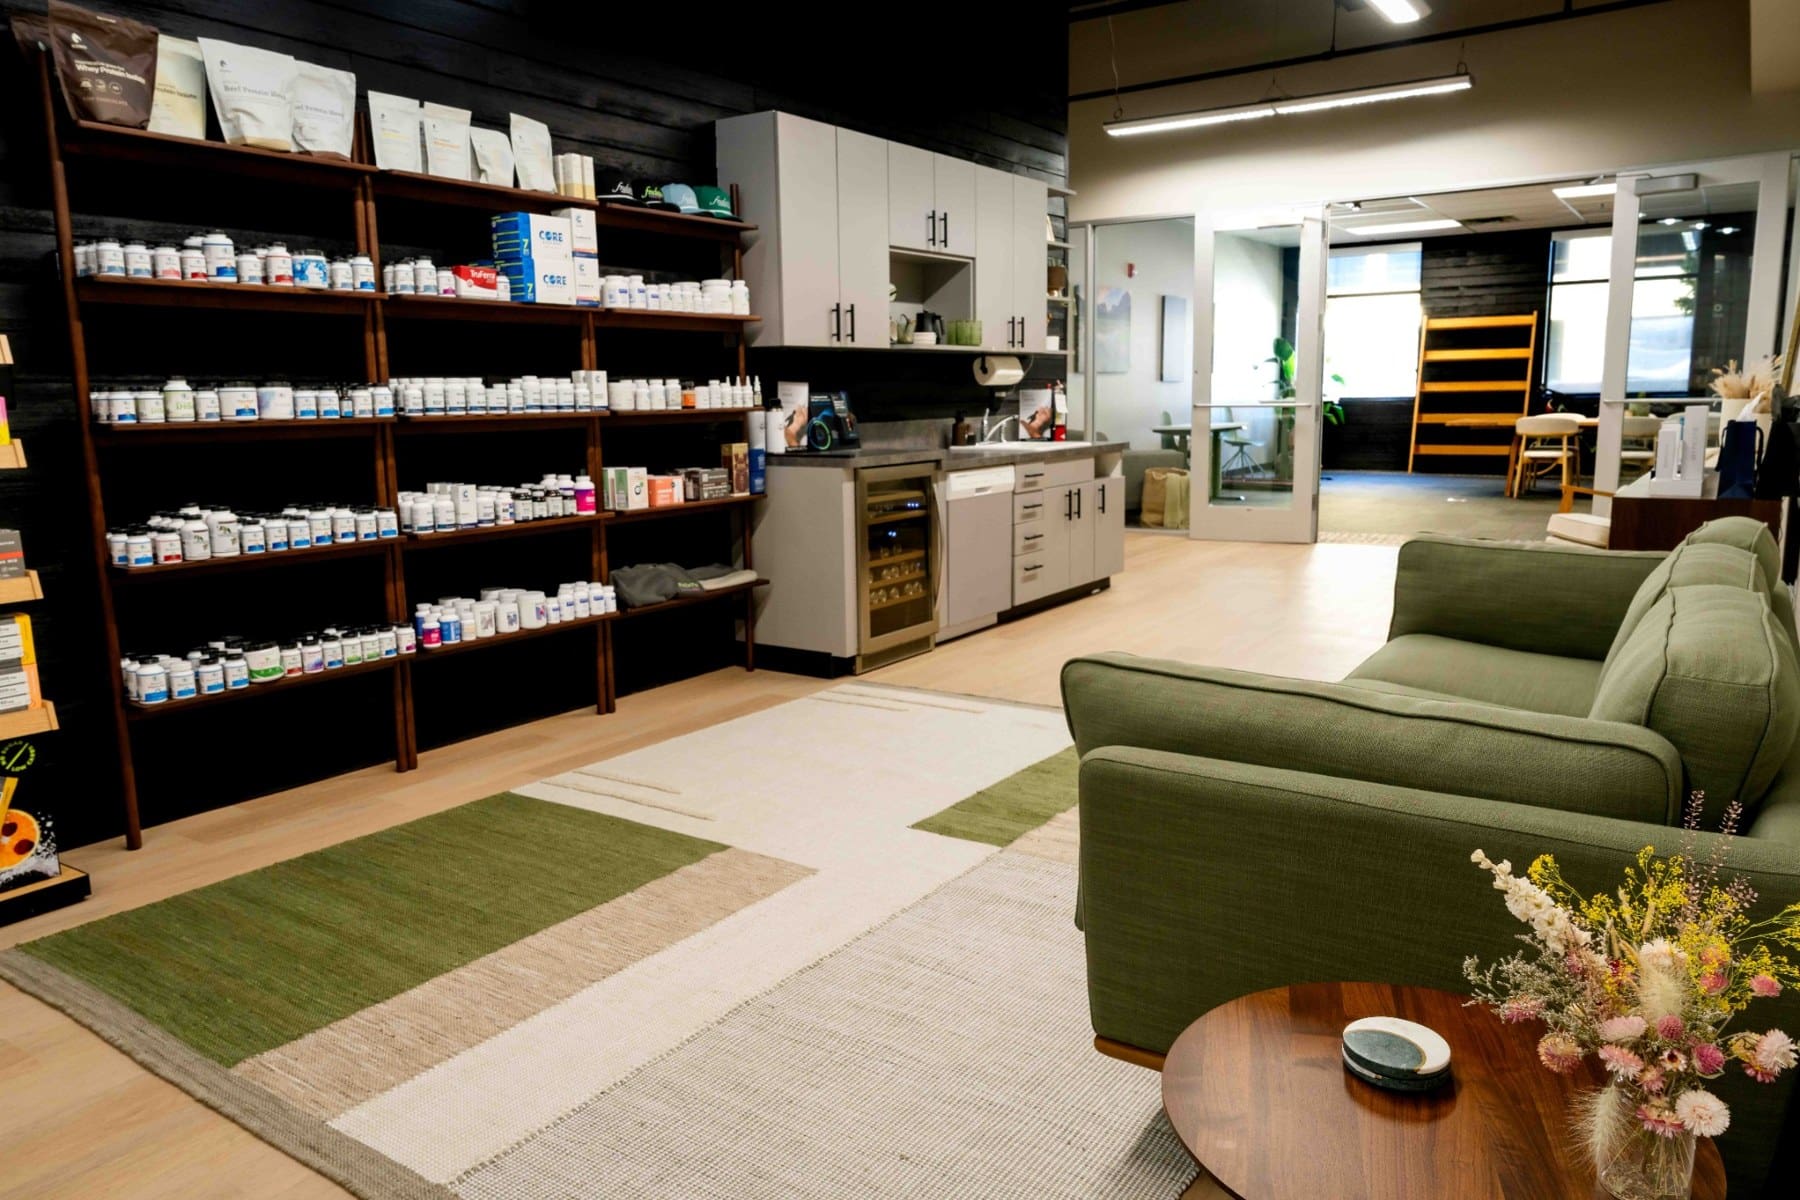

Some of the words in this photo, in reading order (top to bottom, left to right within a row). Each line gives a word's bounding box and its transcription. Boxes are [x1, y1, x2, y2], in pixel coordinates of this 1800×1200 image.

[75, 63, 99, 74] Whey
[100, 66, 127, 78] Protein
[538, 230, 564, 242] CORE
[522, 239, 529, 249] 7
[543, 274, 568, 286] CORE
[527, 283, 534, 293] 7
